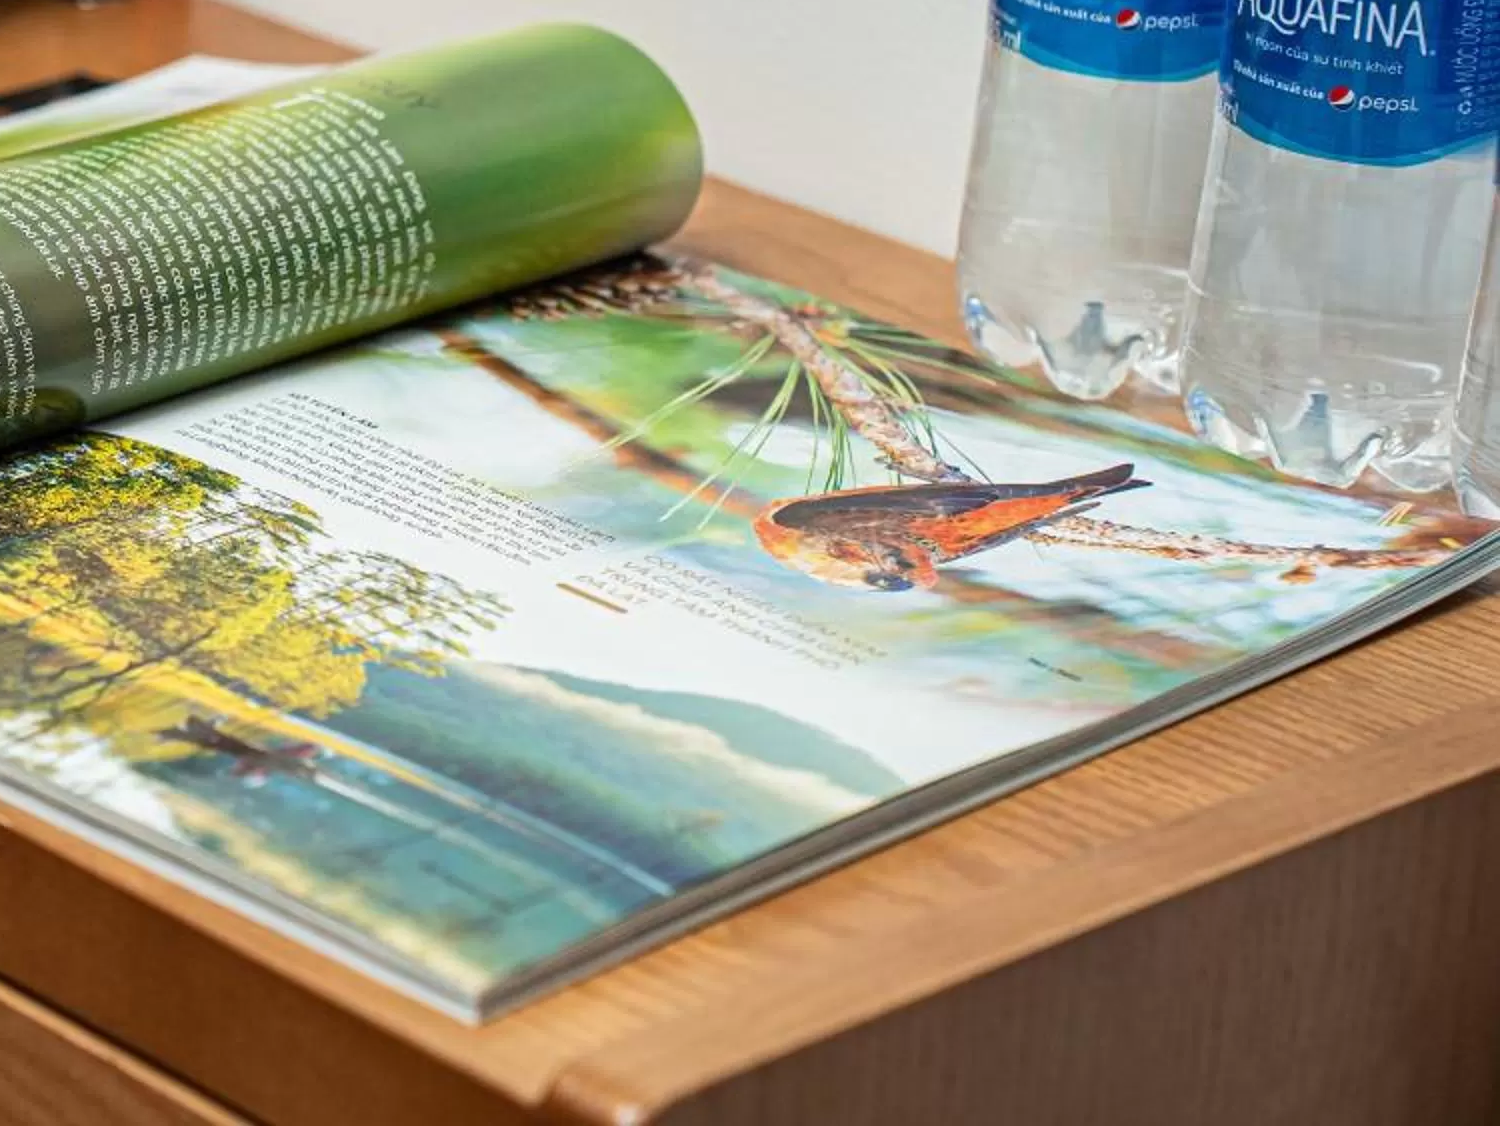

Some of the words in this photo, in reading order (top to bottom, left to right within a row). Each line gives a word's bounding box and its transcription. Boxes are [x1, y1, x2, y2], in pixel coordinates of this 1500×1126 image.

[1144, 13, 1196, 32] pepsi
[1358, 95, 1419, 114] pepsi
[189, 266, 207, 300] 8/13
[20, 328, 35, 362] 5km
[94, 327, 106, 364] chim
